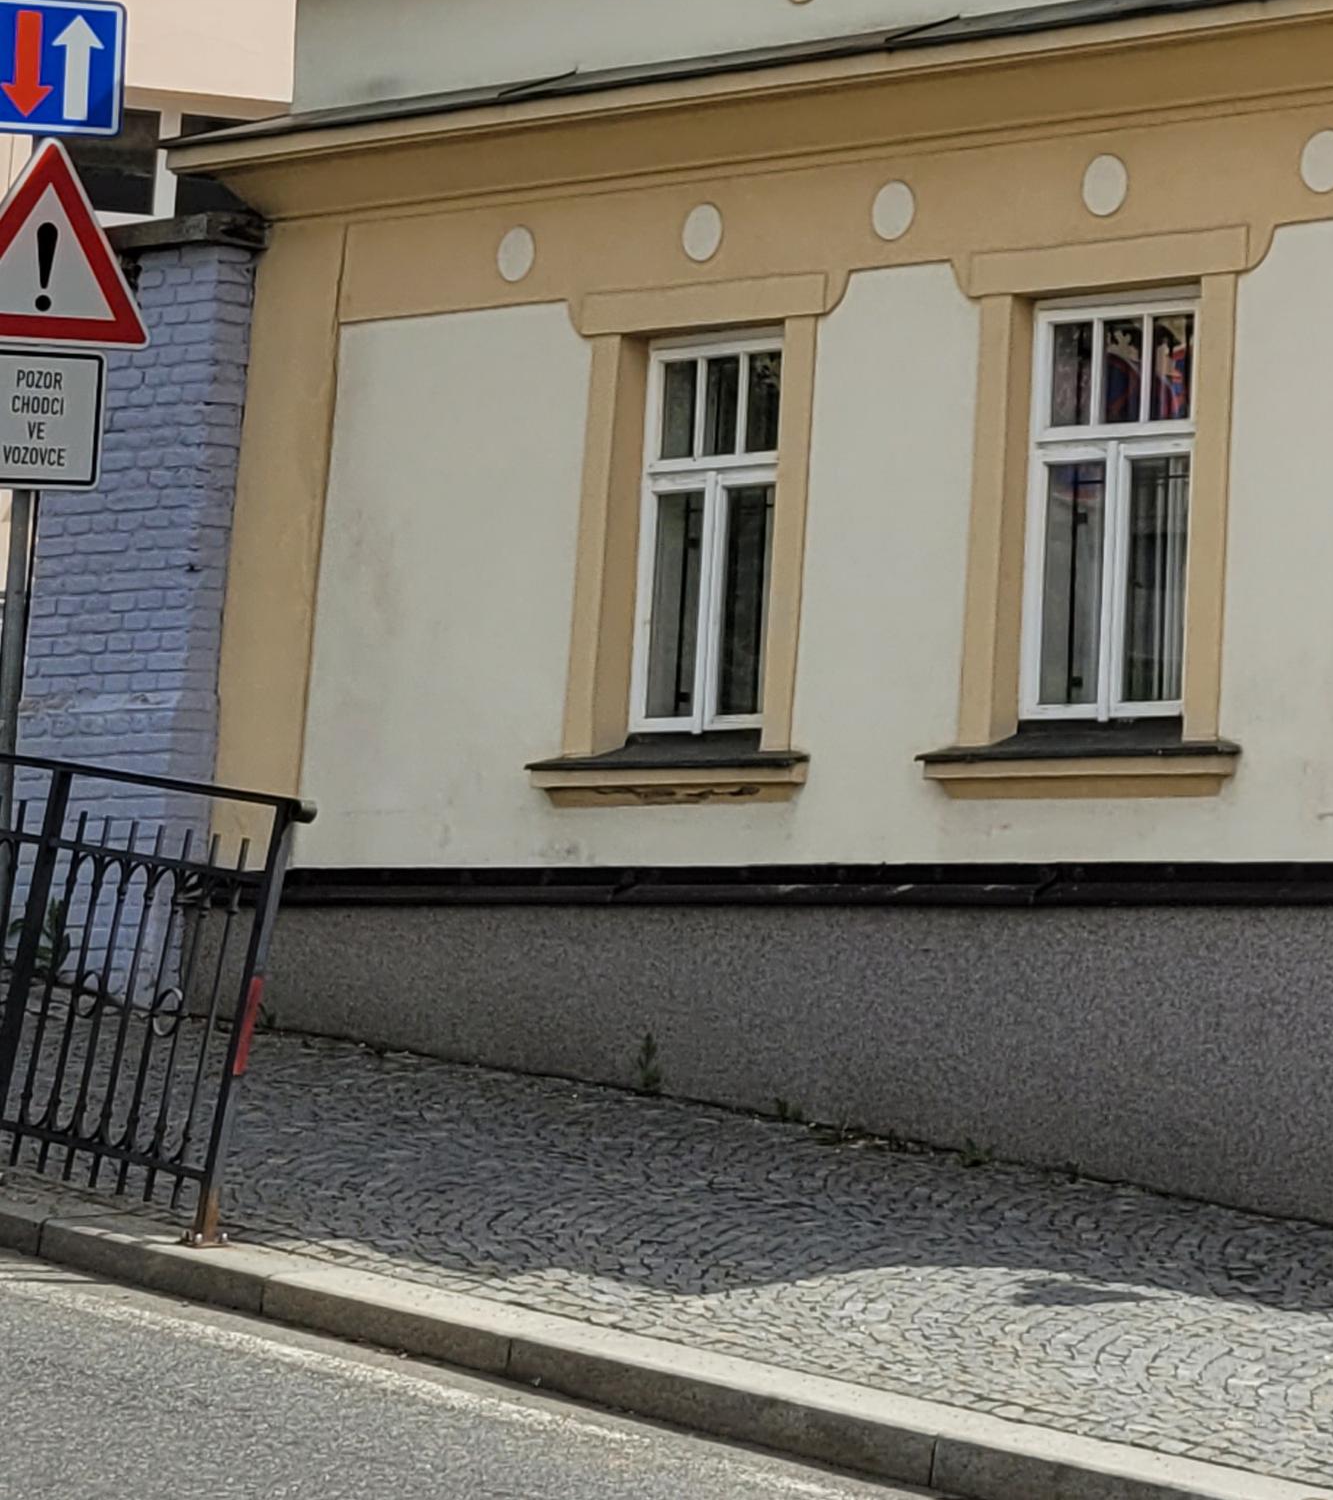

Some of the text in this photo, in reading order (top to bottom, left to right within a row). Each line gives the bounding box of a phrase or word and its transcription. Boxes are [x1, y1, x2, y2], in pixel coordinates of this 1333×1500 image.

[16, 369, 63, 390] POZOR
[11, 395, 65, 416] CHODCI
[27, 421, 46, 440] VE
[3, 445, 67, 467] VOZOVCE
